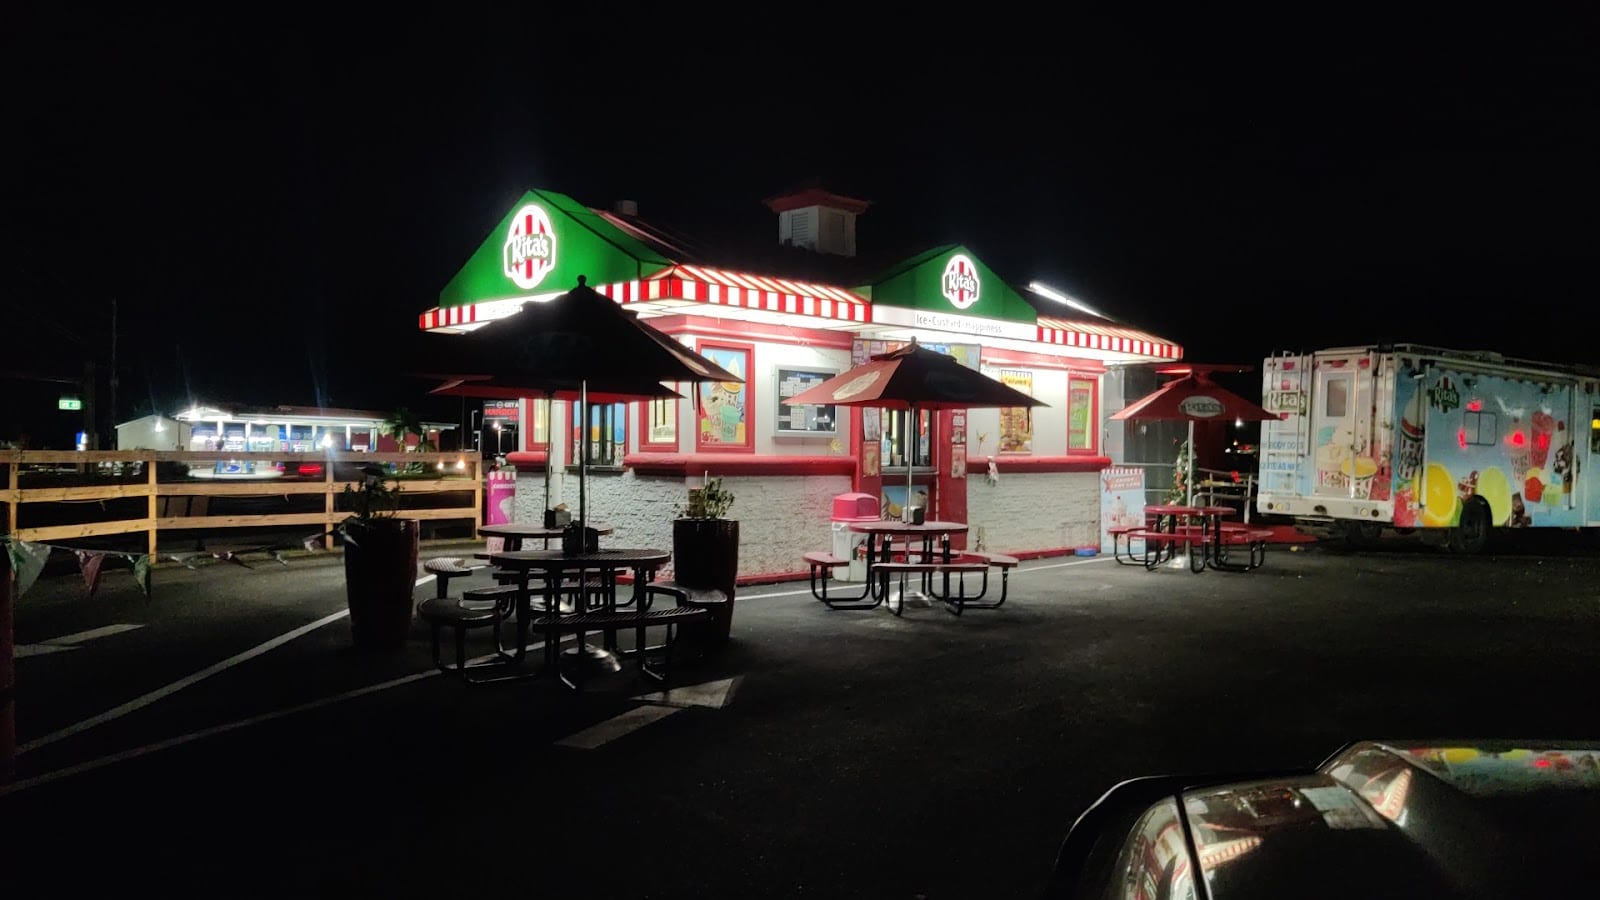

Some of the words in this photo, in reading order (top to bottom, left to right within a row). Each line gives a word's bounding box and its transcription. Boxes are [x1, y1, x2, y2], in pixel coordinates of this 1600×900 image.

[511, 234, 549, 265] Rita's
[947, 271, 976, 293] Rita's
[916, 313, 928, 325] Ice
